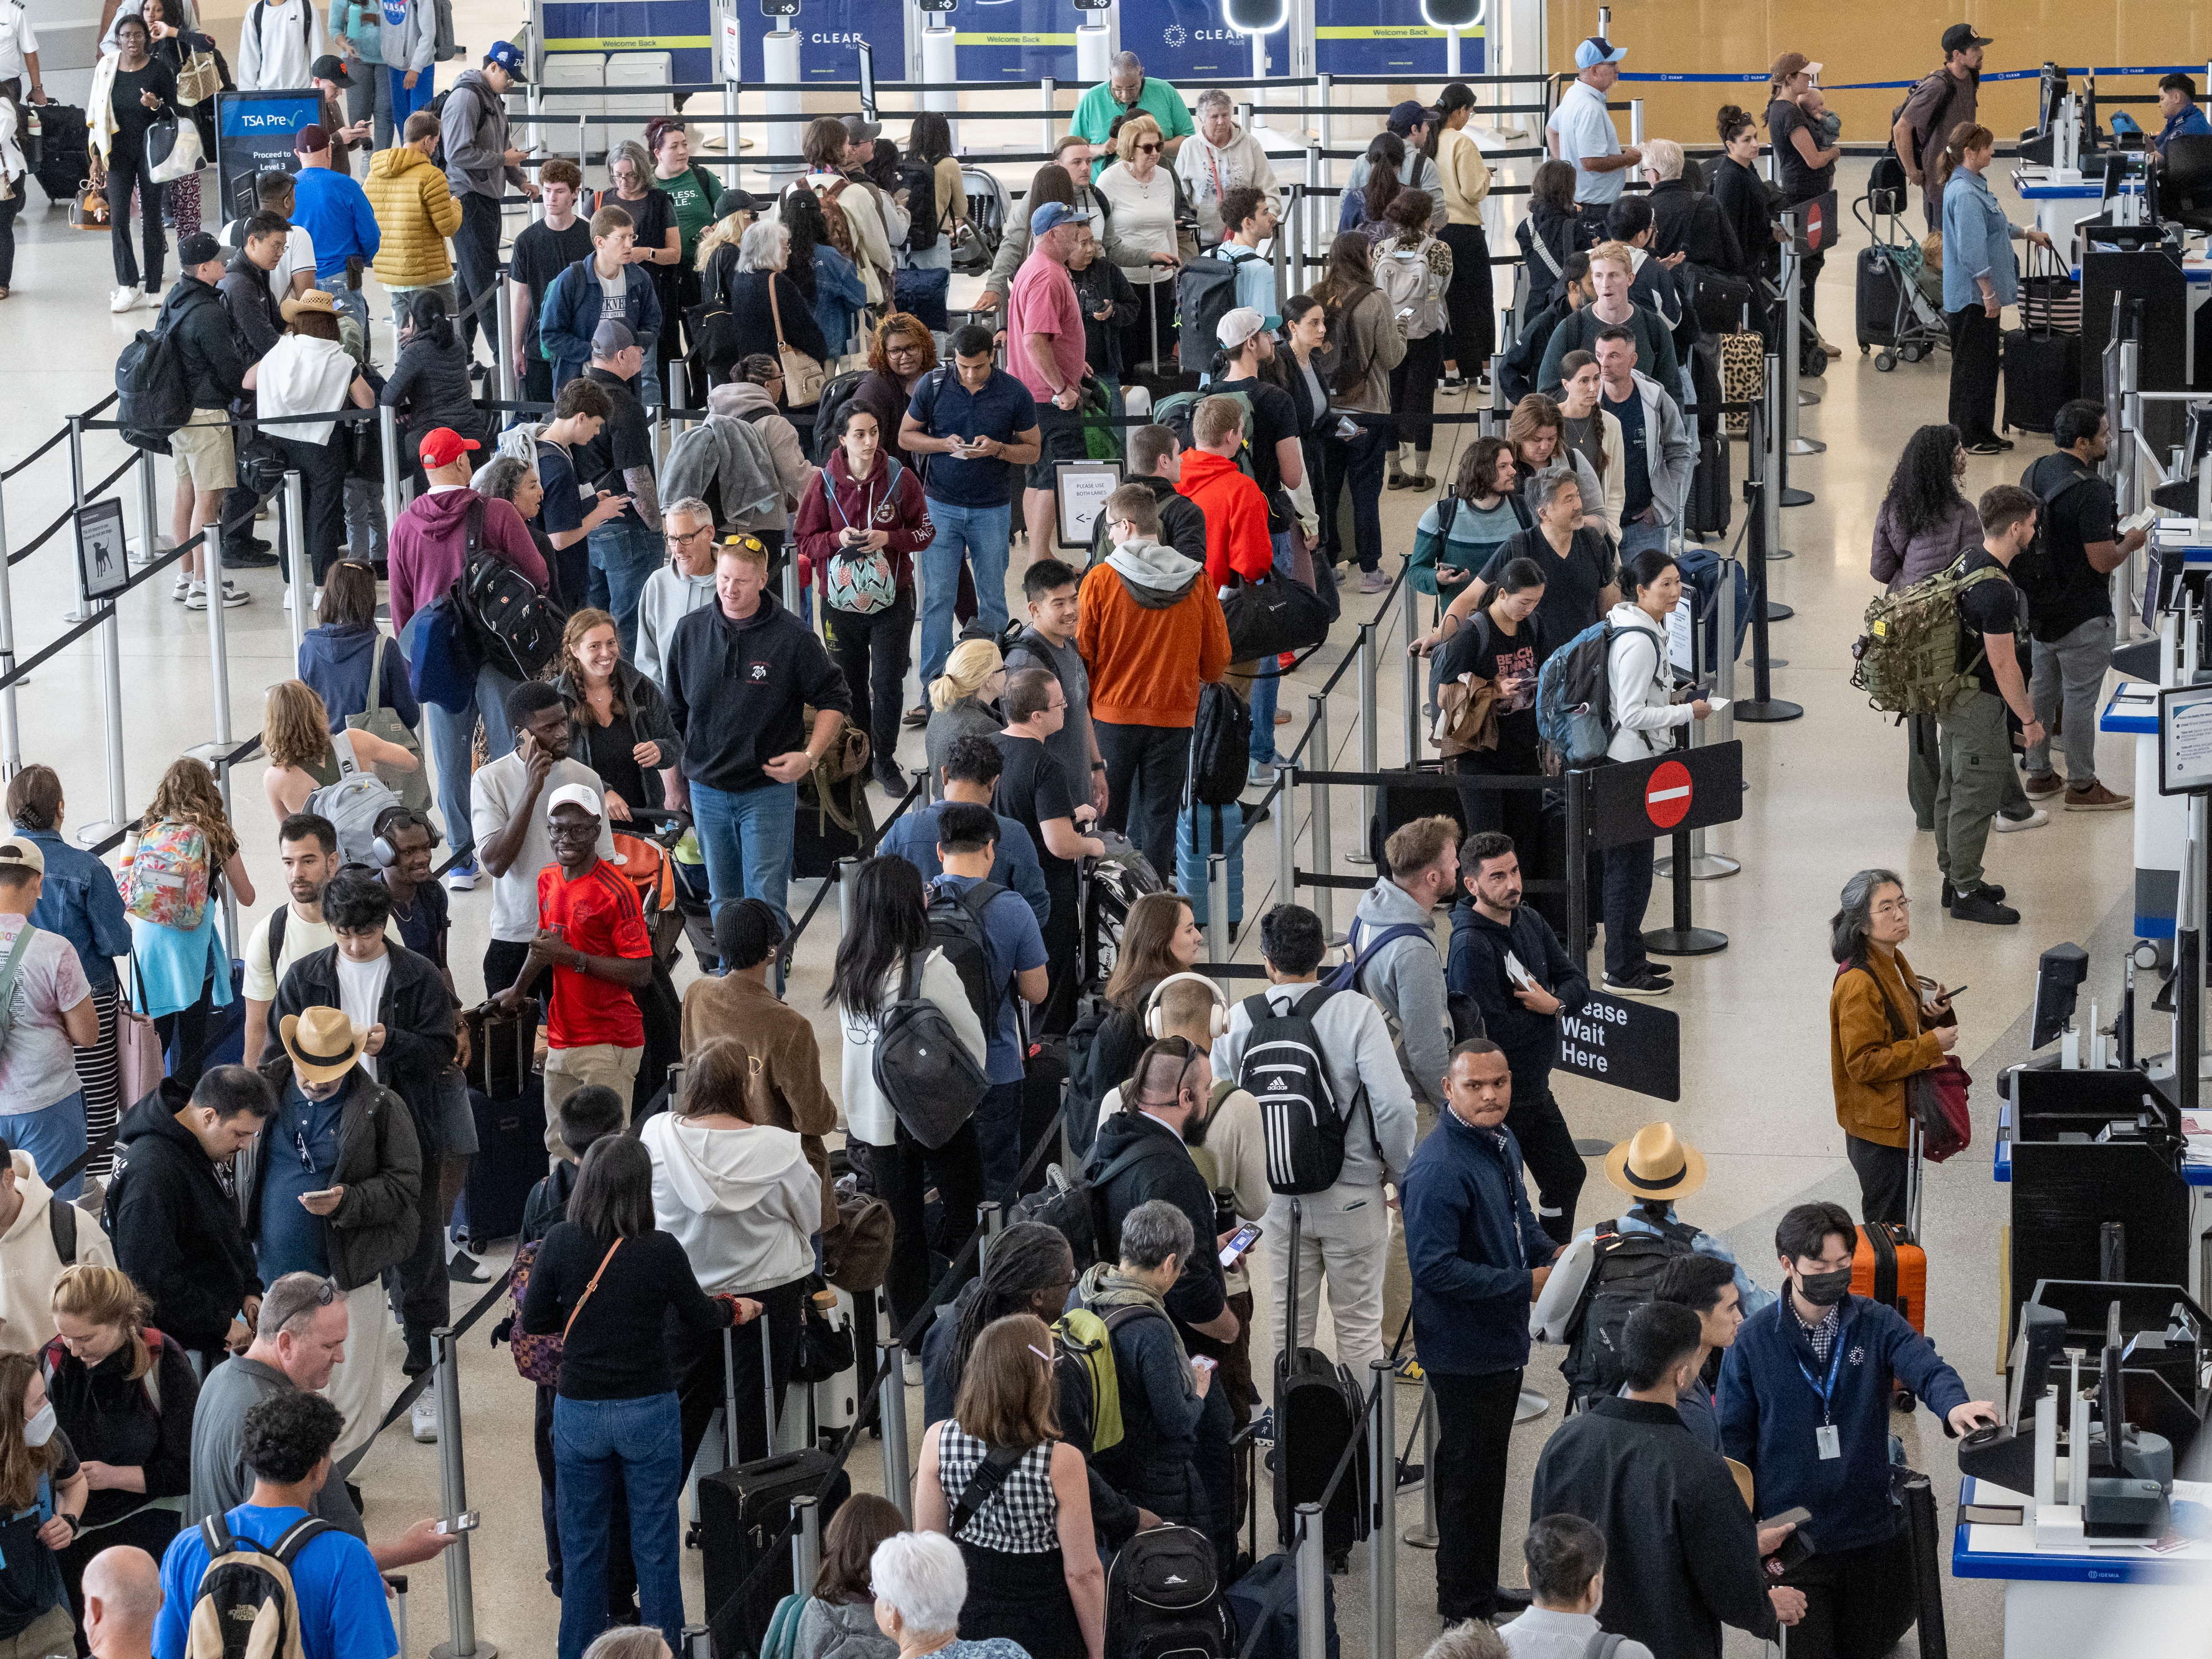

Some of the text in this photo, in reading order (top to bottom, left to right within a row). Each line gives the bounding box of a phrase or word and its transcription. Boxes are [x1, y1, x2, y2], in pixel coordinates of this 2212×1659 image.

[383, 2, 405, 13] NASA
[811, 33, 861, 44] CLEAR
[1195, 29, 1244, 40] CLEAR
[241, 114, 286, 126] TSA Pre
[1581, 1002, 1628, 1026] ease
[1561, 1016, 1605, 1046] Wait
[1562, 1040, 1608, 1072] Here
